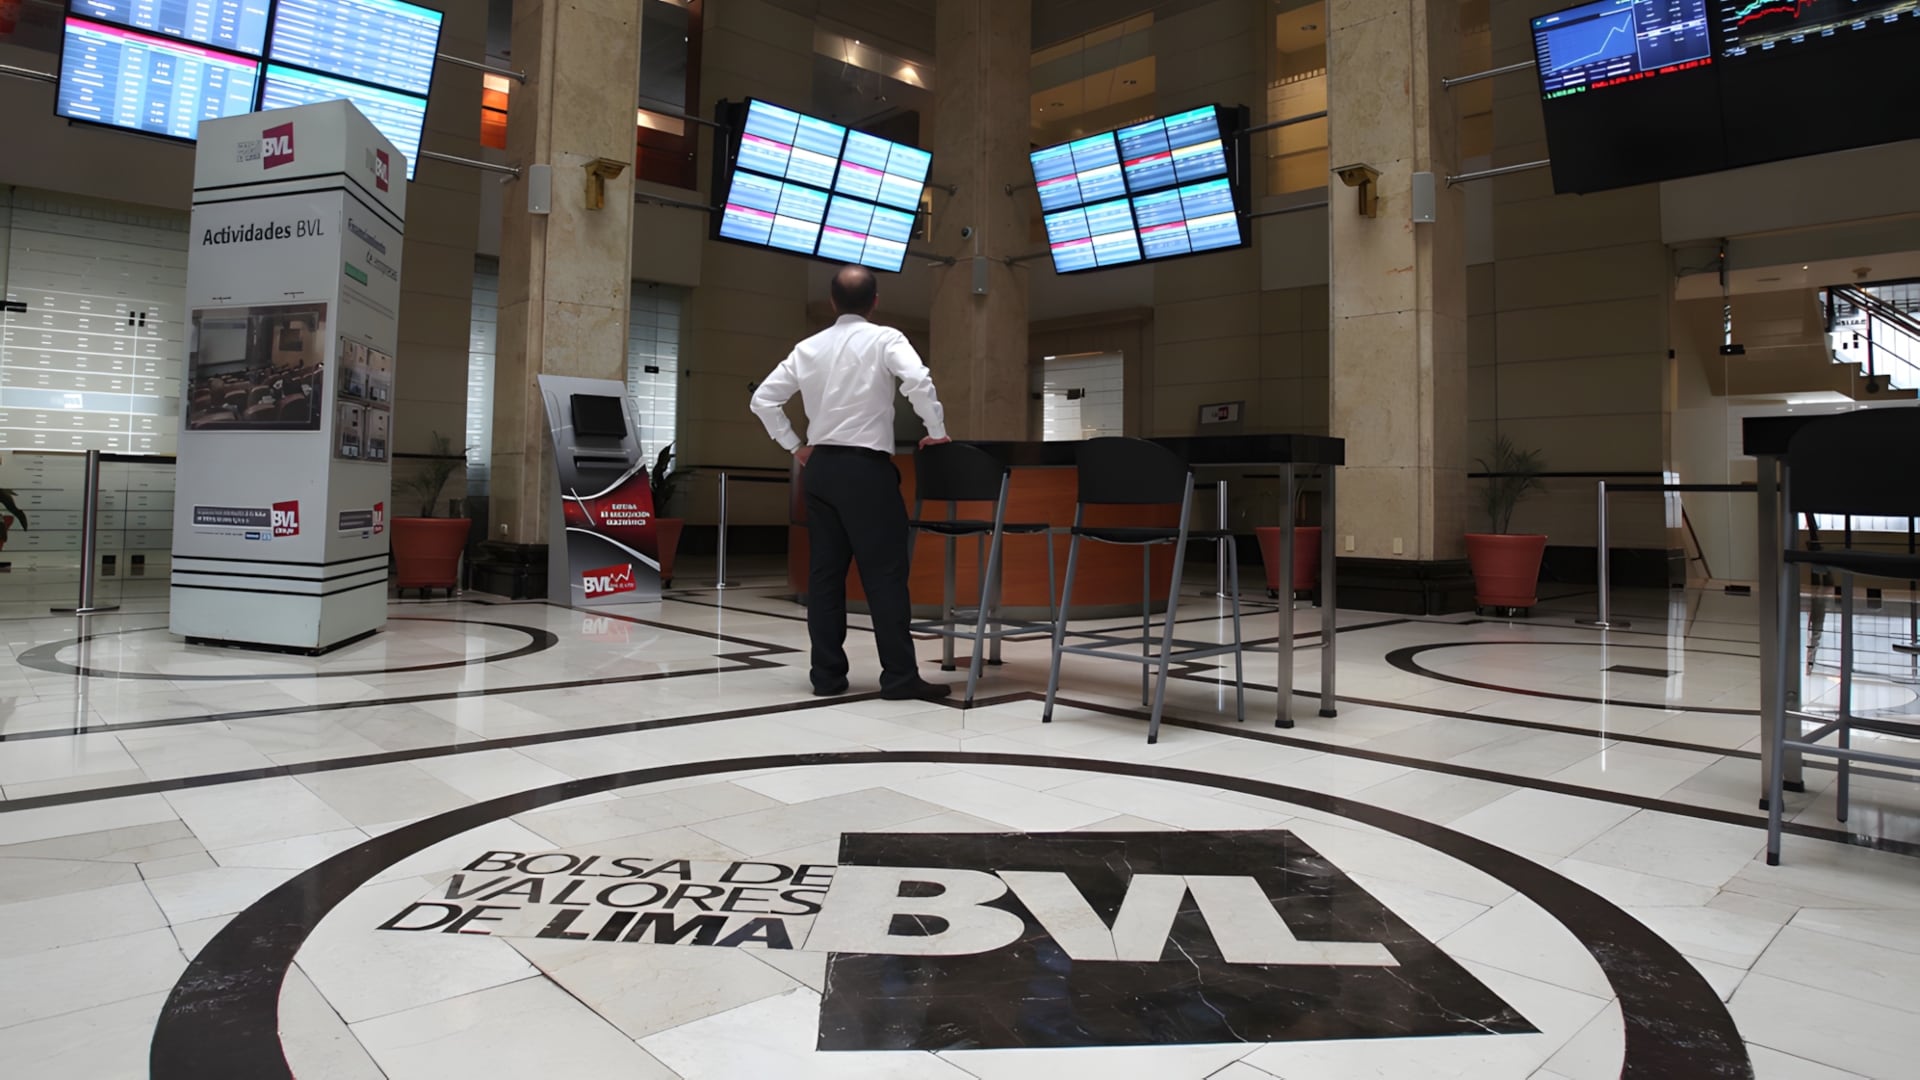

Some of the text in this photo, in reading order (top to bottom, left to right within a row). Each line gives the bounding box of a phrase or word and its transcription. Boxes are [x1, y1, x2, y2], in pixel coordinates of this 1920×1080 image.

[262, 135, 293, 157] BVL
[202, 222, 291, 246] Actividades
[297, 219, 324, 238] BVL
[272, 510, 298, 528] BVL
[583, 575, 614, 593] BVL
[462, 851, 838, 887] BOLSA DE
[444, 874, 827, 916] VALORES
[375, 902, 794, 950] DE LIMA
[802, 865, 1401, 967] BVL
